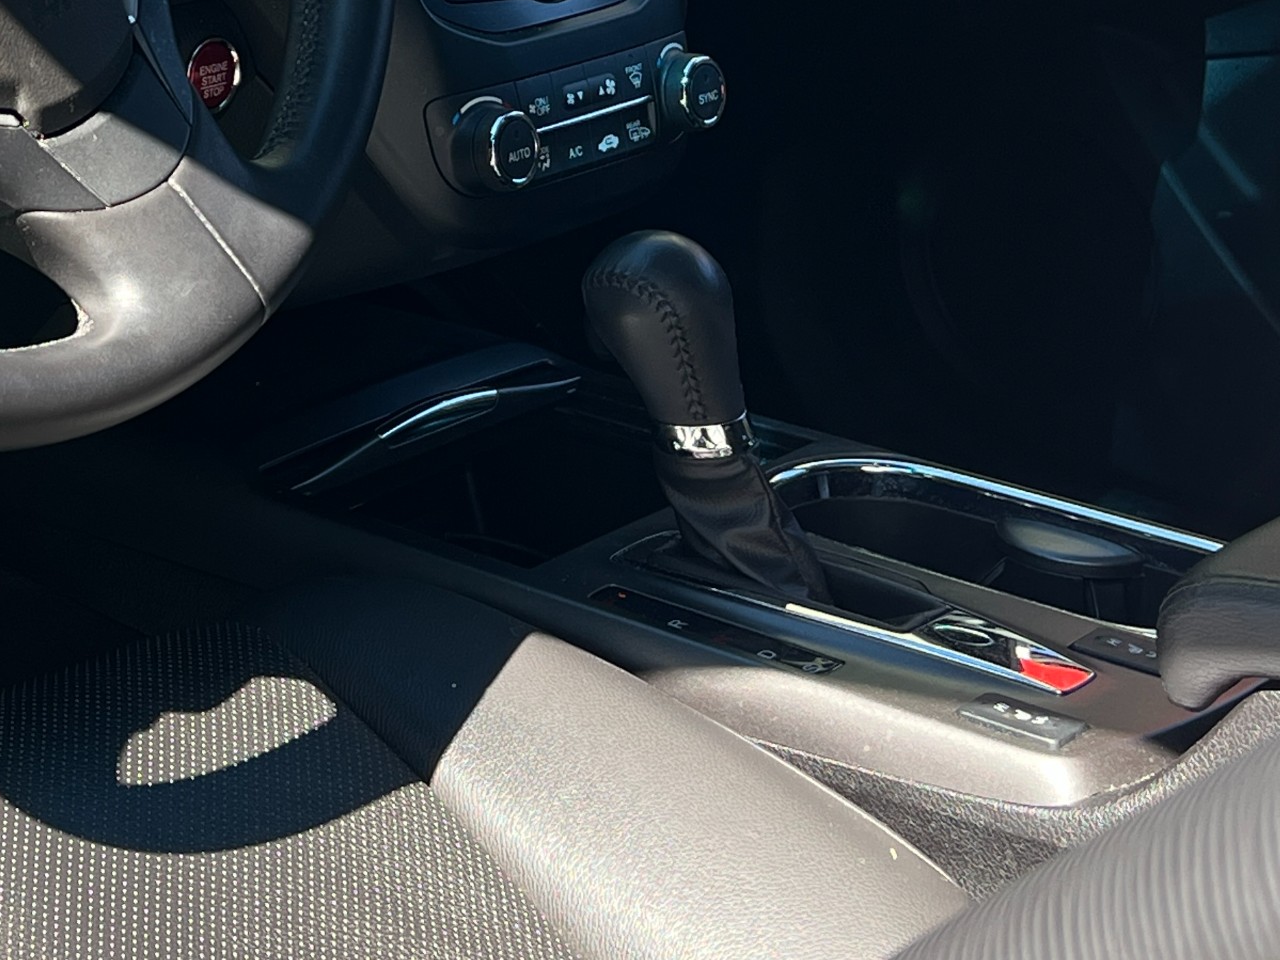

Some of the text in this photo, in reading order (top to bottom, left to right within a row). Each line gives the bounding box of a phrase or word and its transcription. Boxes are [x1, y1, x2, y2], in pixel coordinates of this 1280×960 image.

[200, 60, 229, 77] ENGINE
[201, 72, 228, 87] START
[203, 86, 226, 100] STOP
[698, 91, 719, 106] SYNC
[508, 146, 531, 162] AUTO
[667, 619, 689, 630] R
[756, 649, 777, 660] D
